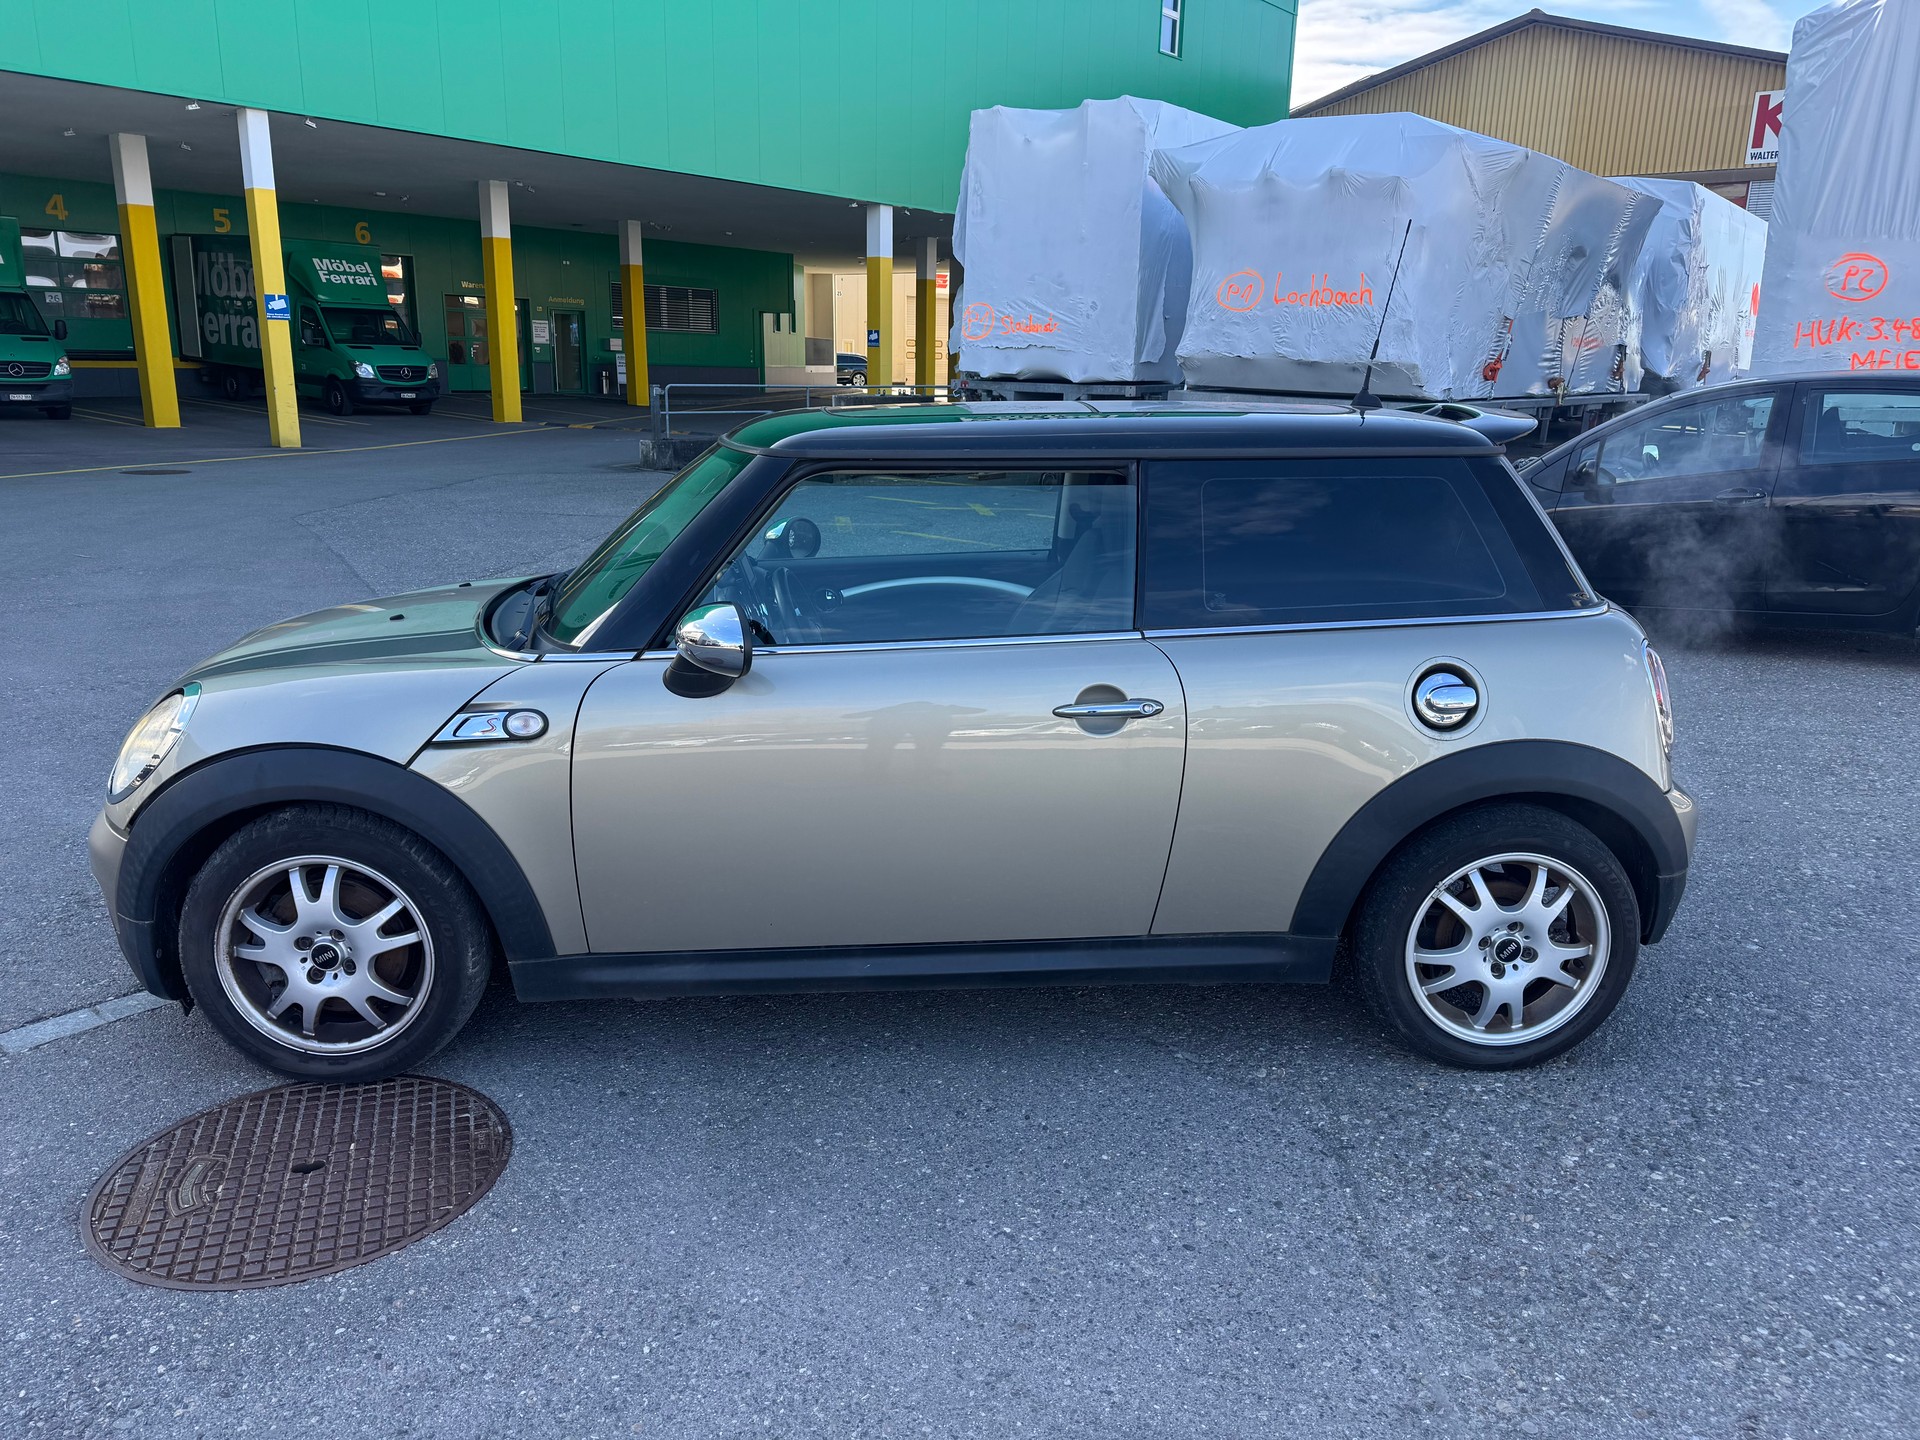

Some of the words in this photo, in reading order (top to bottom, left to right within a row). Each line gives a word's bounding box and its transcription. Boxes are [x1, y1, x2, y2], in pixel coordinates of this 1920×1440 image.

[1750, 150, 1779, 161] WALTER
[45, 193, 69, 220] 4
[213, 208, 231, 233] 5
[355, 221, 371, 245] 6
[312, 257, 373, 274] Möbel
[318, 270, 378, 286] Ferrari
[1273, 271, 1374, 308] Lochbach
[548, 295, 585, 306] Anmeldung
[315, 949, 336, 965] MINI
[1500, 942, 1518, 959] MINI
